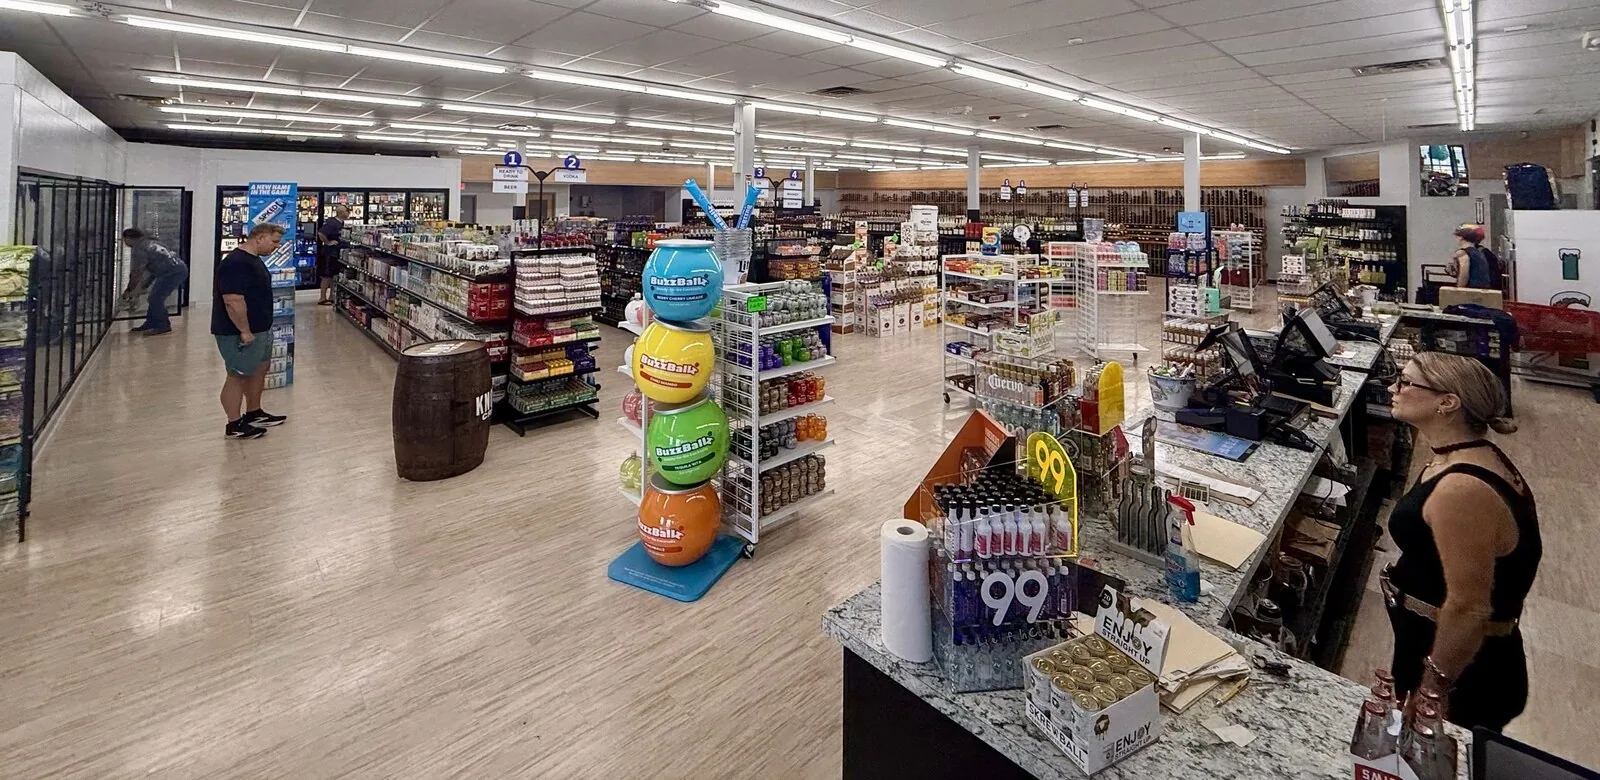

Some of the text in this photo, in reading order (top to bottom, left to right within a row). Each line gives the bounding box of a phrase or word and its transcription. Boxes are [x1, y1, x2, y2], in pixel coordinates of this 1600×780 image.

[508, 153, 518, 165] 1
[568, 157, 577, 169] 2
[757, 168, 763, 177] 3
[791, 170, 798, 179] 4
[650, 275, 709, 287] BuzzBallz
[640, 353, 699, 375] BuzzBallz
[988, 372, 1024, 393] Cuervo
[655, 435, 715, 457] BuzzBallz
[1035, 439, 1065, 495] 99
[980, 569, 1049, 627] 99
[1101, 628, 1139, 658] STRAIGHT
[1139, 653, 1151, 665] UP
[1102, 615, 1153, 657] ENJOY
[1029, 703, 1086, 764] SKREWBALL
[1115, 721, 1152, 753] ENJOY
[1114, 738, 1143, 761] STRAIGHT
